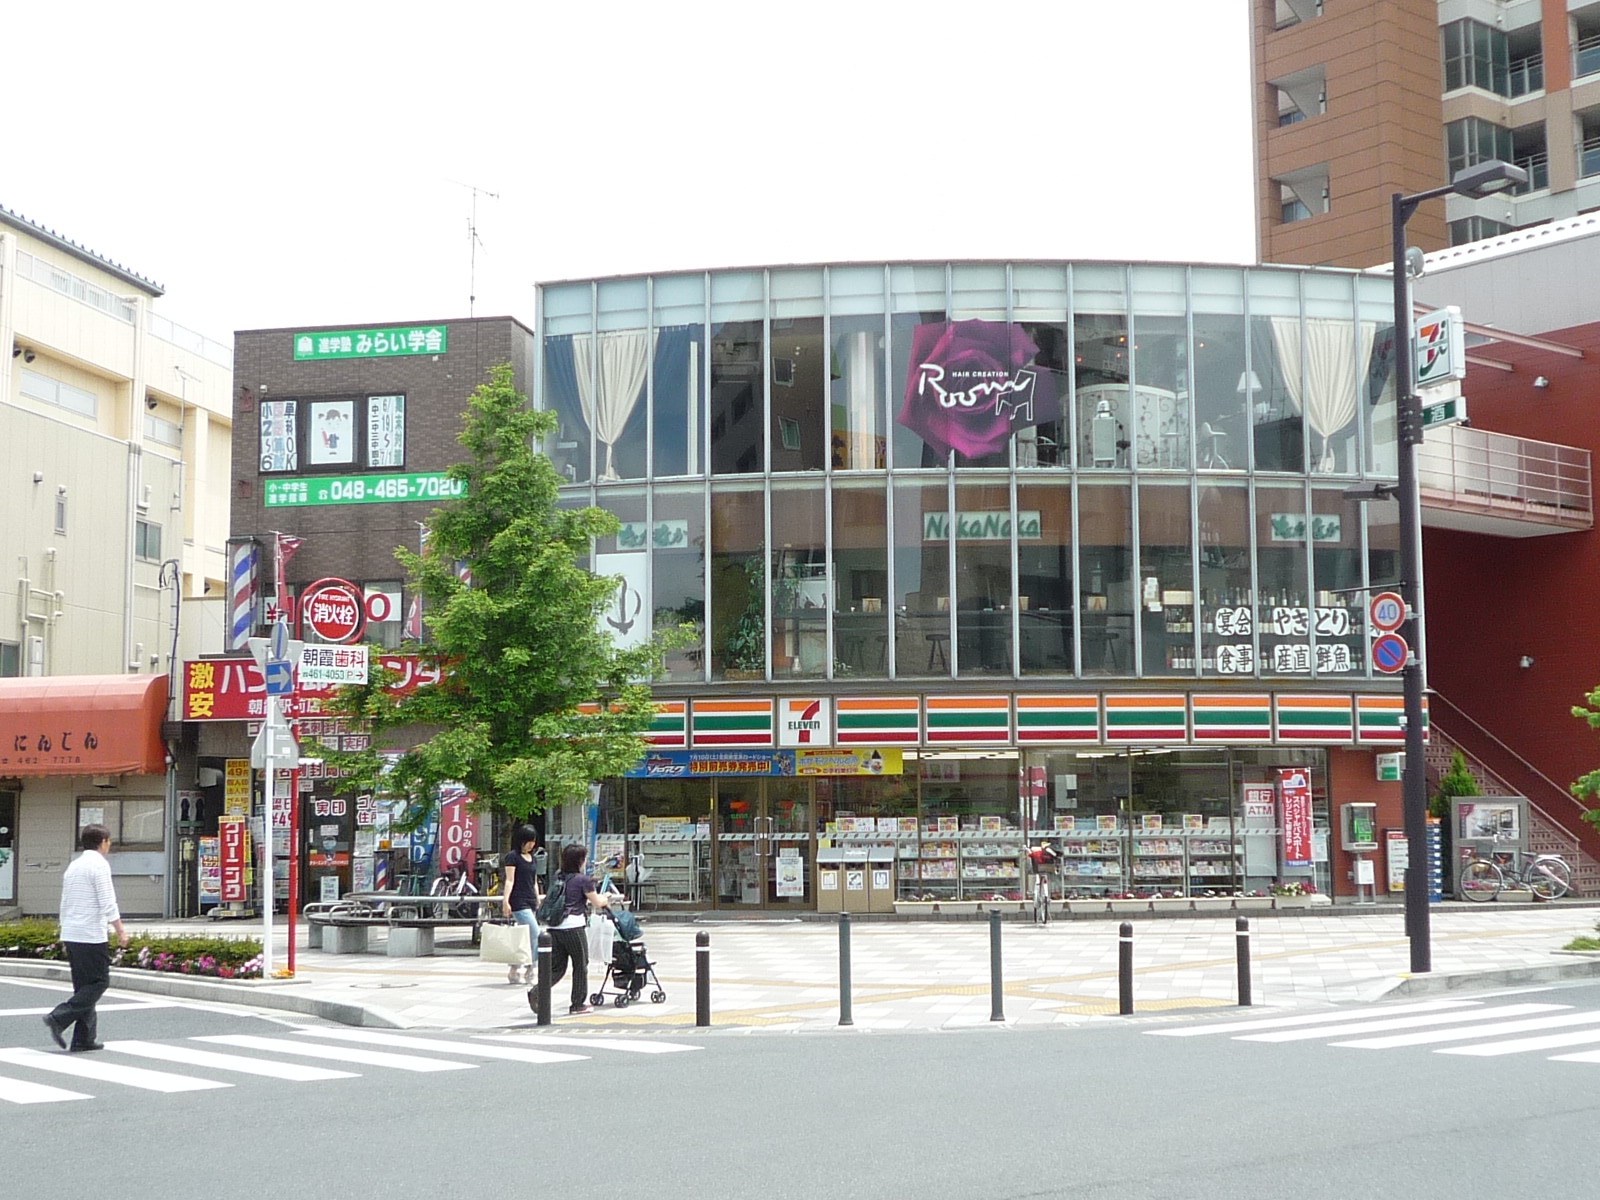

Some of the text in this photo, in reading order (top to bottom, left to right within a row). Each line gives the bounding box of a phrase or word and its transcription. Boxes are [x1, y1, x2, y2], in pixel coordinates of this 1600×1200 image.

[318, 329, 442, 354] 進学塾 みらい学舎
[1431, 403, 1445, 423] 酒
[330, 477, 462, 500] 048-465-7020
[313, 603, 354, 626] 消火栓
[1378, 604, 1397, 620] 40
[1217, 609, 1251, 634] 宴会
[1275, 609, 1347, 635] やきとり
[303, 649, 365, 668] 朝霞歯科
[1219, 645, 1349, 671] 食事 産直鮮魚
[189, 662, 214, 718] 激安
[788, 720, 820, 730] ELEVEN
[14, 732, 98, 751] にんじん
[1247, 790, 1272, 803] 銀行
[315, 800, 346, 816] 実印
[1248, 805, 1272, 815] ATM
